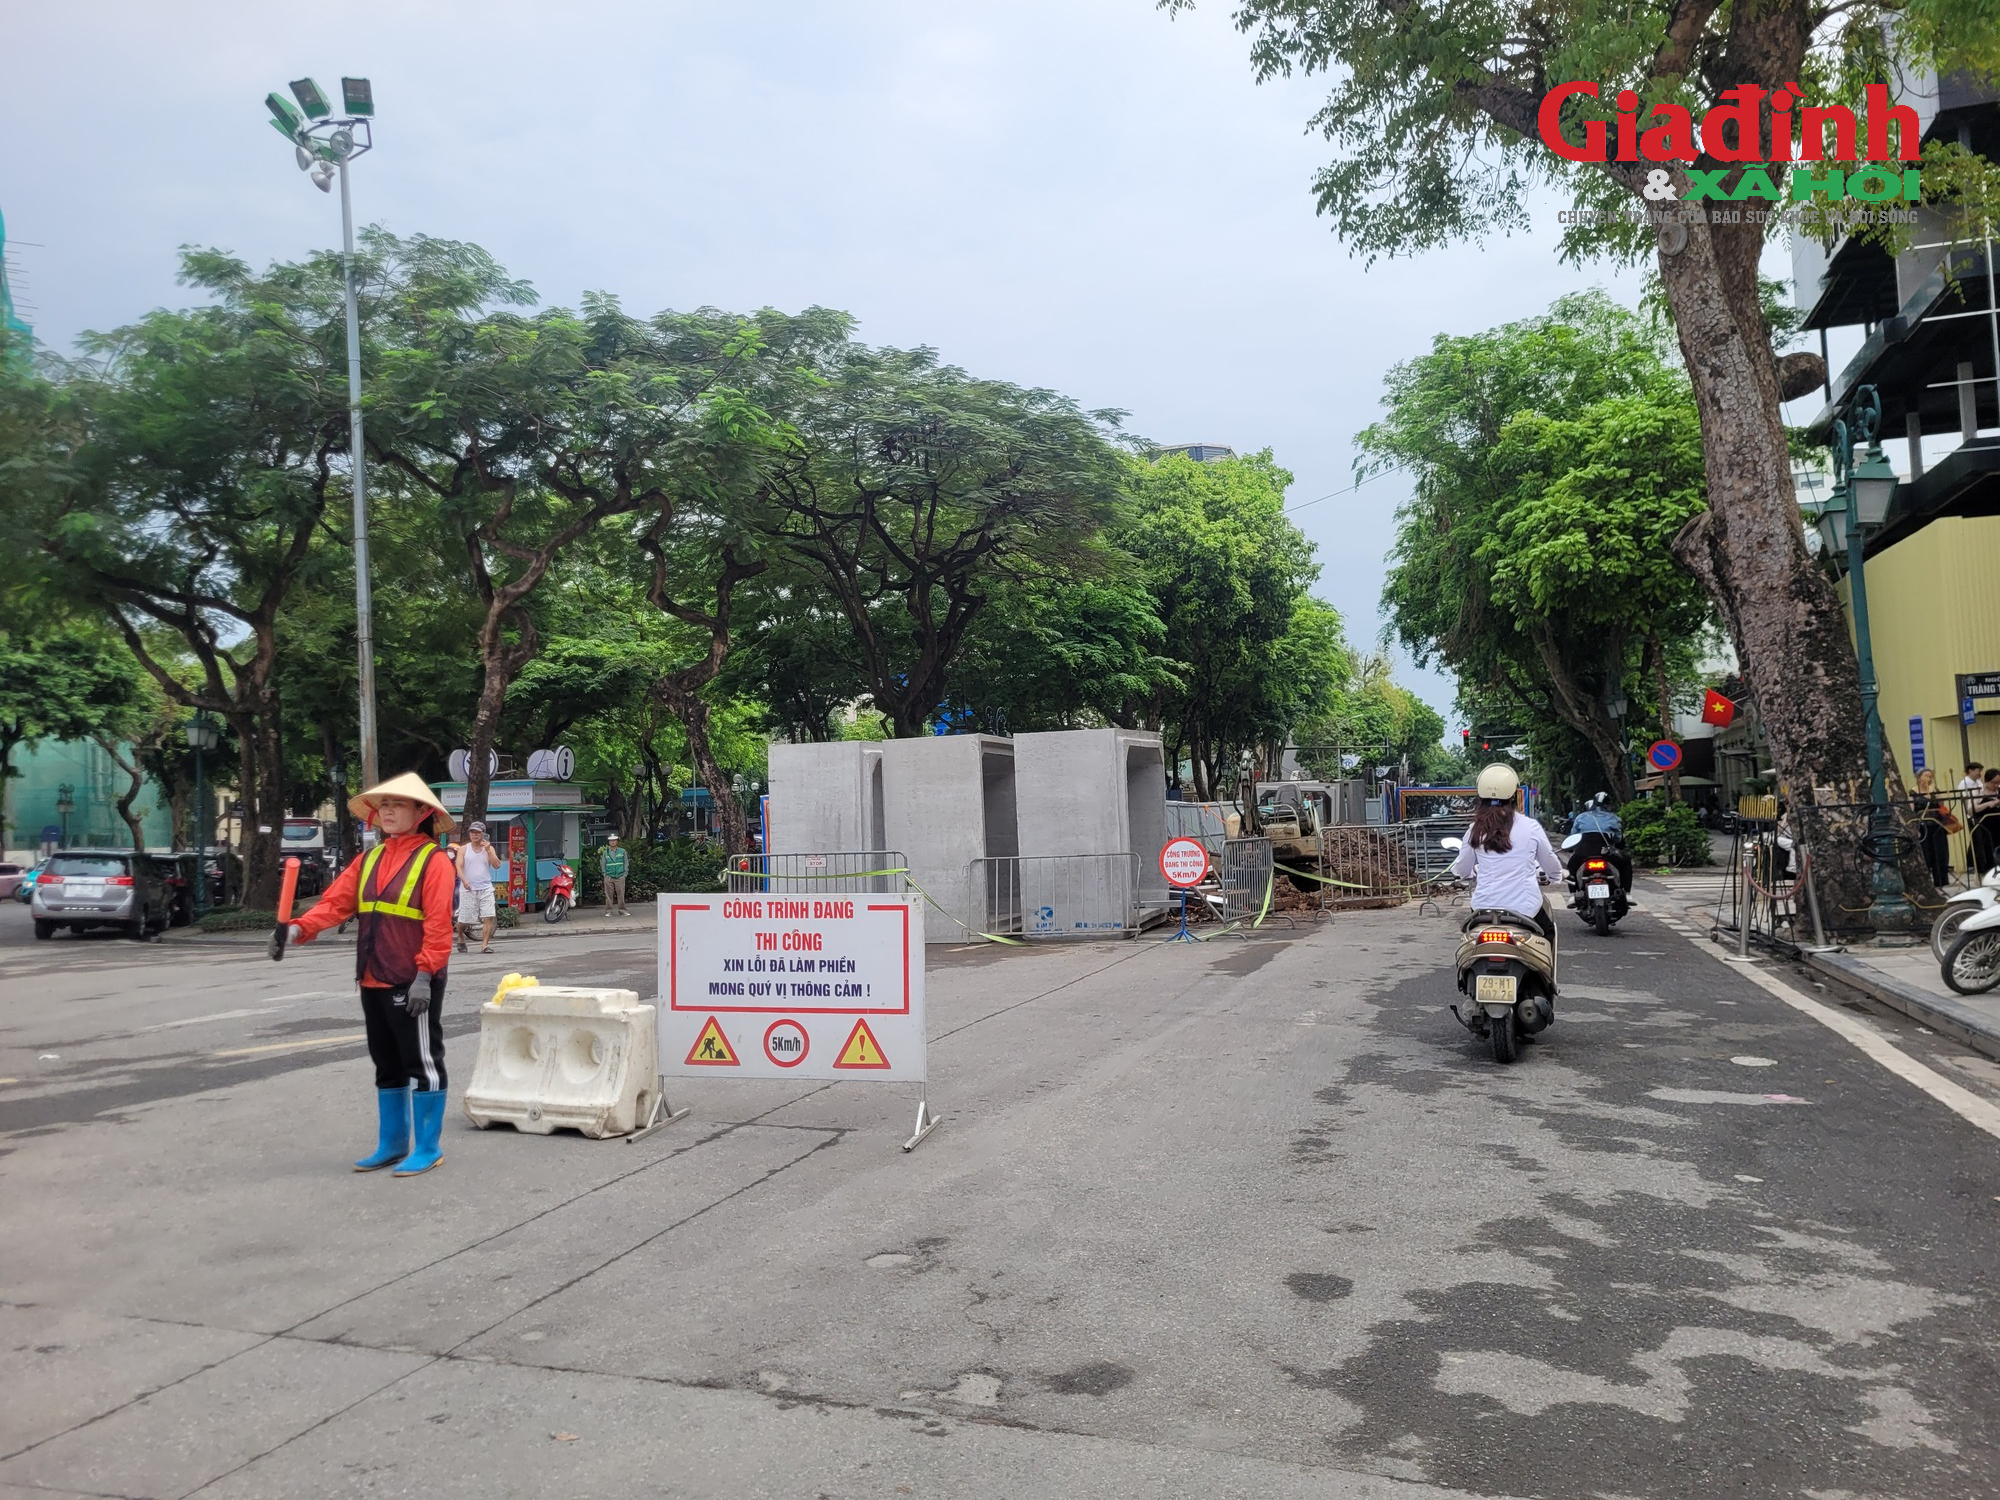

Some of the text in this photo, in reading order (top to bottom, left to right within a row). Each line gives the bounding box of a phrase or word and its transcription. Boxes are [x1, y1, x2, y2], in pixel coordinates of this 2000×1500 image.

[723, 897, 854, 919] CÔNG TRÌNH ĐANG
[754, 928, 822, 951] THI CÔNG
[723, 958, 744, 972] XIN
[747, 954, 766, 973] LỖI
[769, 956, 786, 973] ĐÃ
[789, 956, 815, 973] LÀM
[708, 982, 745, 996] MONG
[748, 980, 772, 997] QUÝ
[775, 983, 787, 999] VỊ
[790, 980, 831, 997] THÔNG
[834, 979, 862, 997] CẢM
[772, 1036, 801, 1052] 5Km/h
